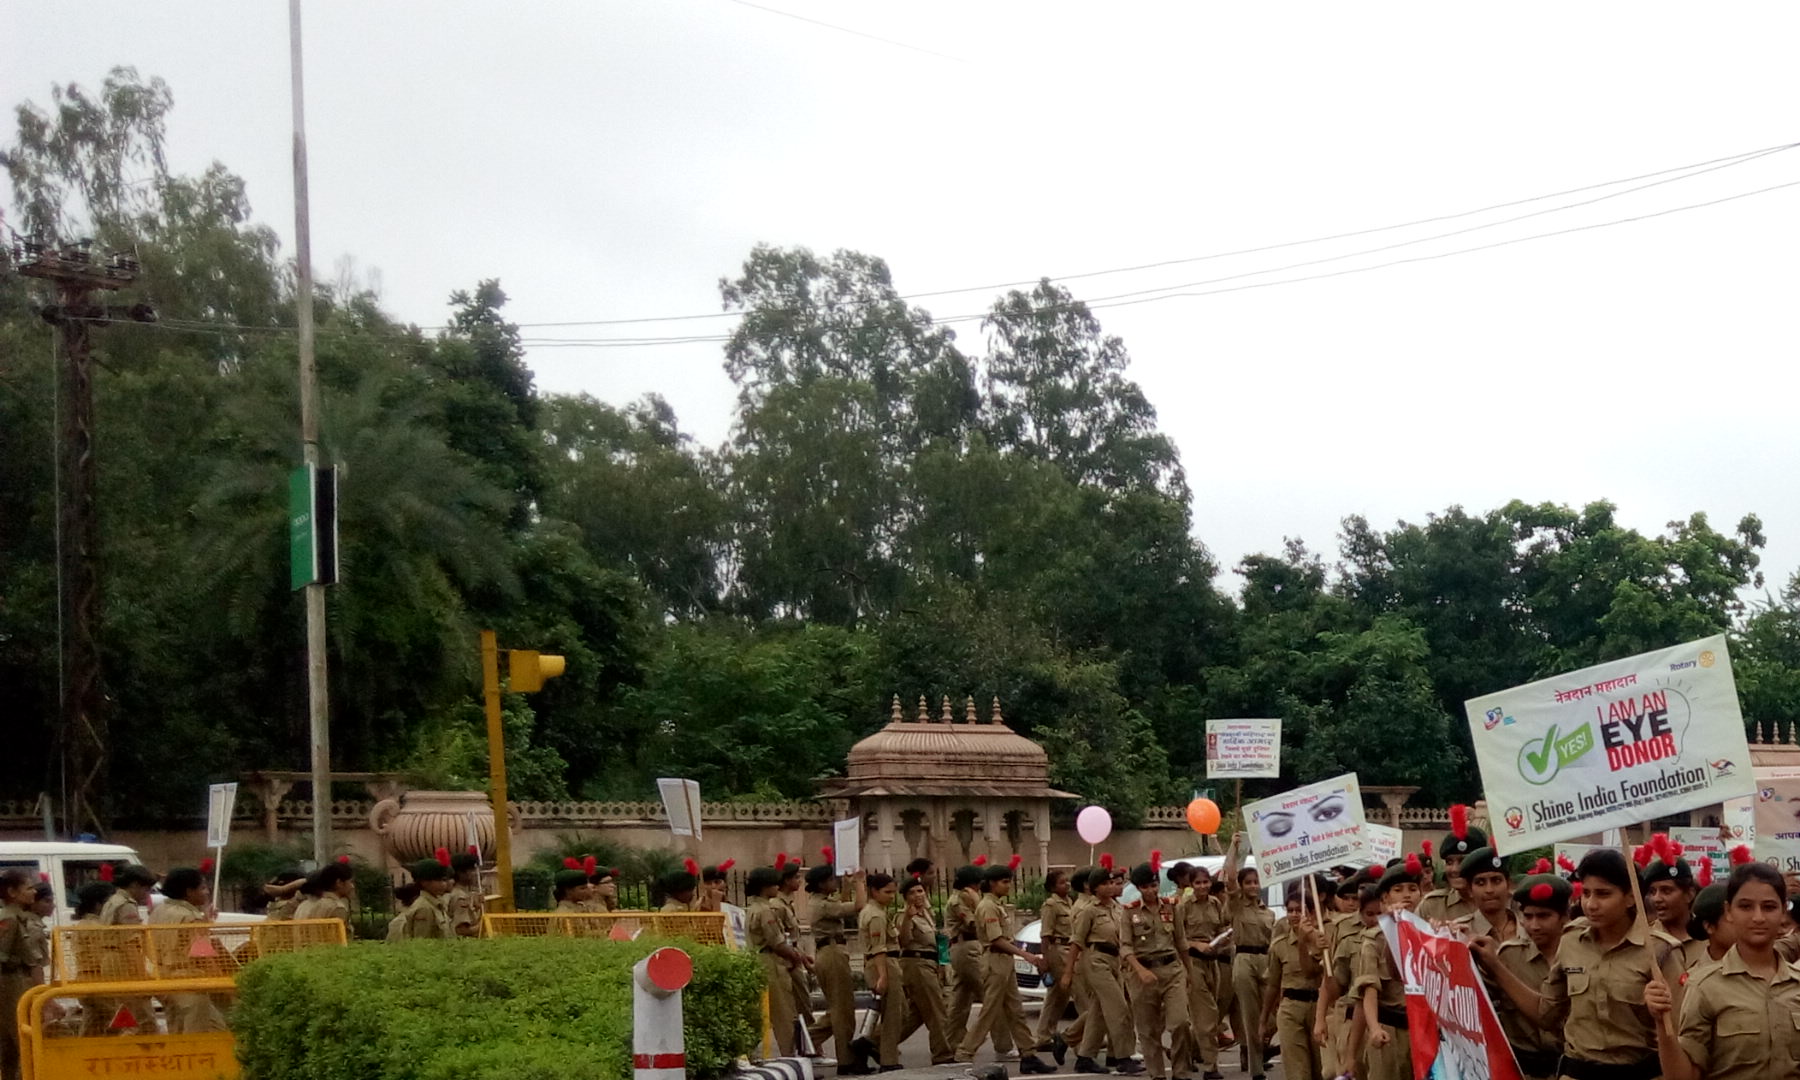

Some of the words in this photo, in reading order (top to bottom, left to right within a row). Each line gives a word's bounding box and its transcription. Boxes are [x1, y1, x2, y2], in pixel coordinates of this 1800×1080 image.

[1670, 659, 1697, 673] Rotary
[1554, 684, 1592, 704] नेत्रदान
[1596, 674, 1638, 694] महादान
[1609, 698, 1637, 721] AM
[1642, 690, 1668, 714] AN
[1600, 709, 1673, 748] EYE
[1560, 731, 1588, 759] YES!
[1606, 733, 1677, 772] DONOR
[1532, 799, 1575, 824] Shine
[1578, 785, 1617, 811] India
[1620, 766, 1705, 801] Foundation
[1274, 858, 1291, 872] Shine
[1292, 853, 1309, 866] India
[1311, 844, 1349, 861] Foundation
